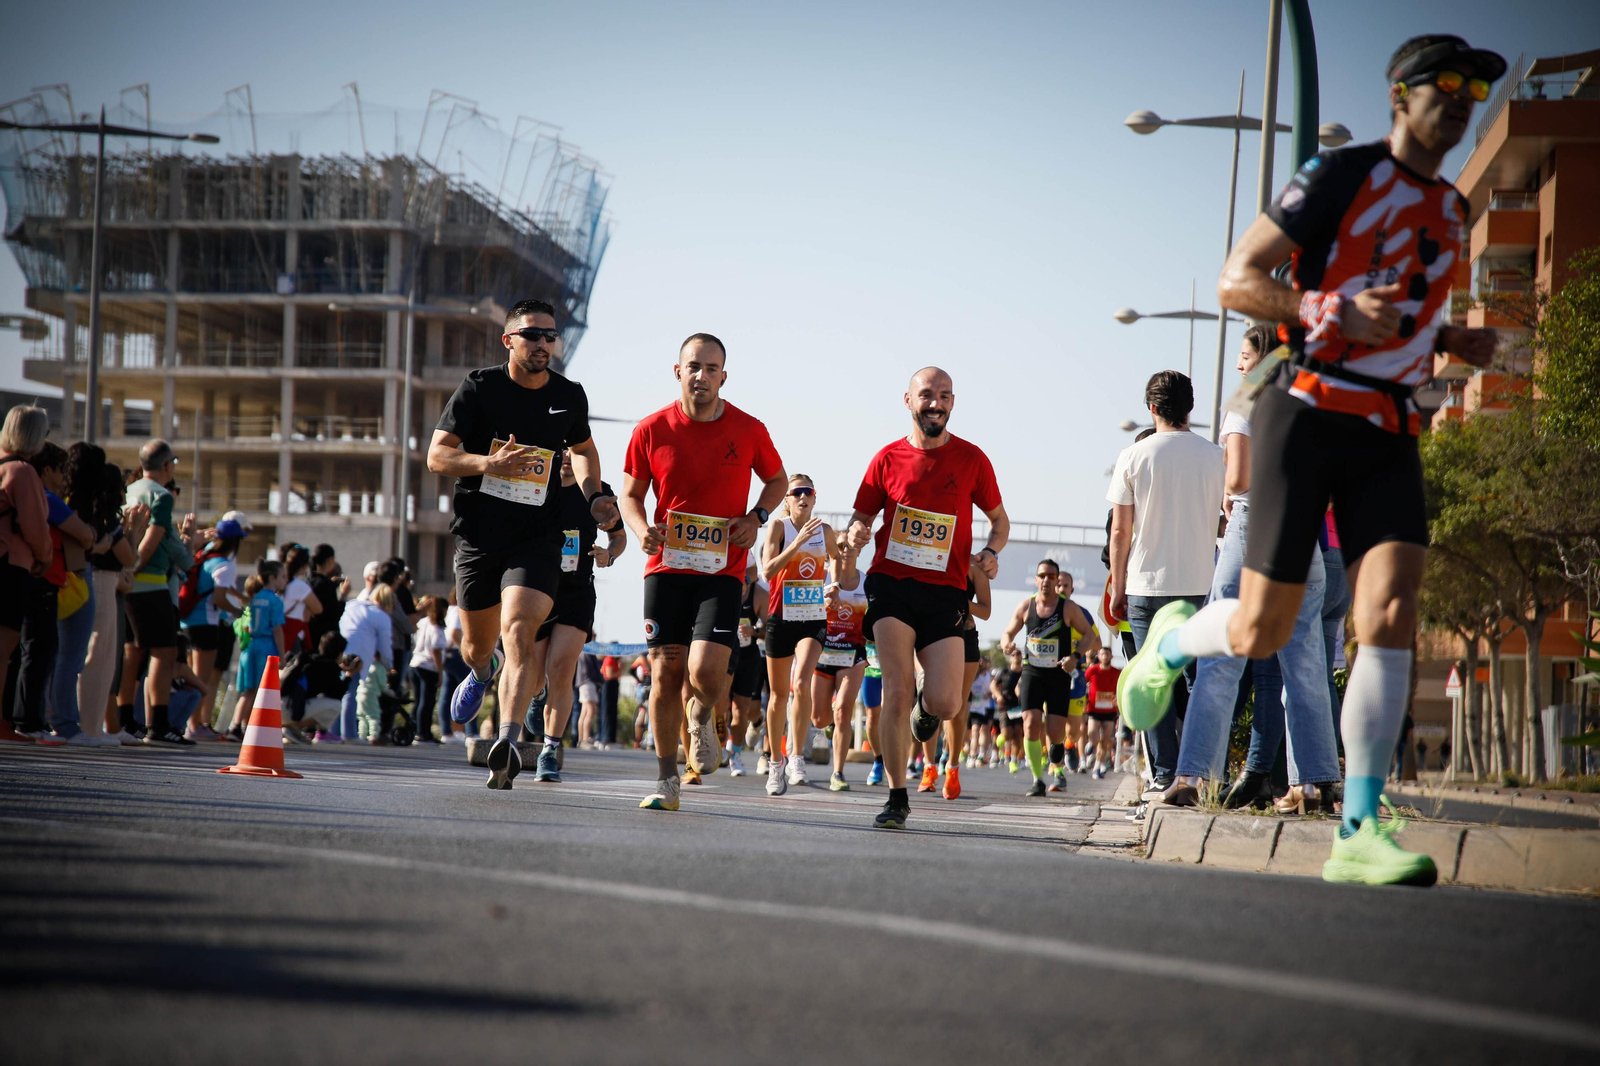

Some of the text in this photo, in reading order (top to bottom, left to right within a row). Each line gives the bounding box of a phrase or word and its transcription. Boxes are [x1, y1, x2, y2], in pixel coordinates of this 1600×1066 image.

[674, 523, 722, 545] 1940
[899, 517, 947, 541] 1939
[789, 587, 821, 600] 1373
[1032, 644, 1055, 653] 1820
